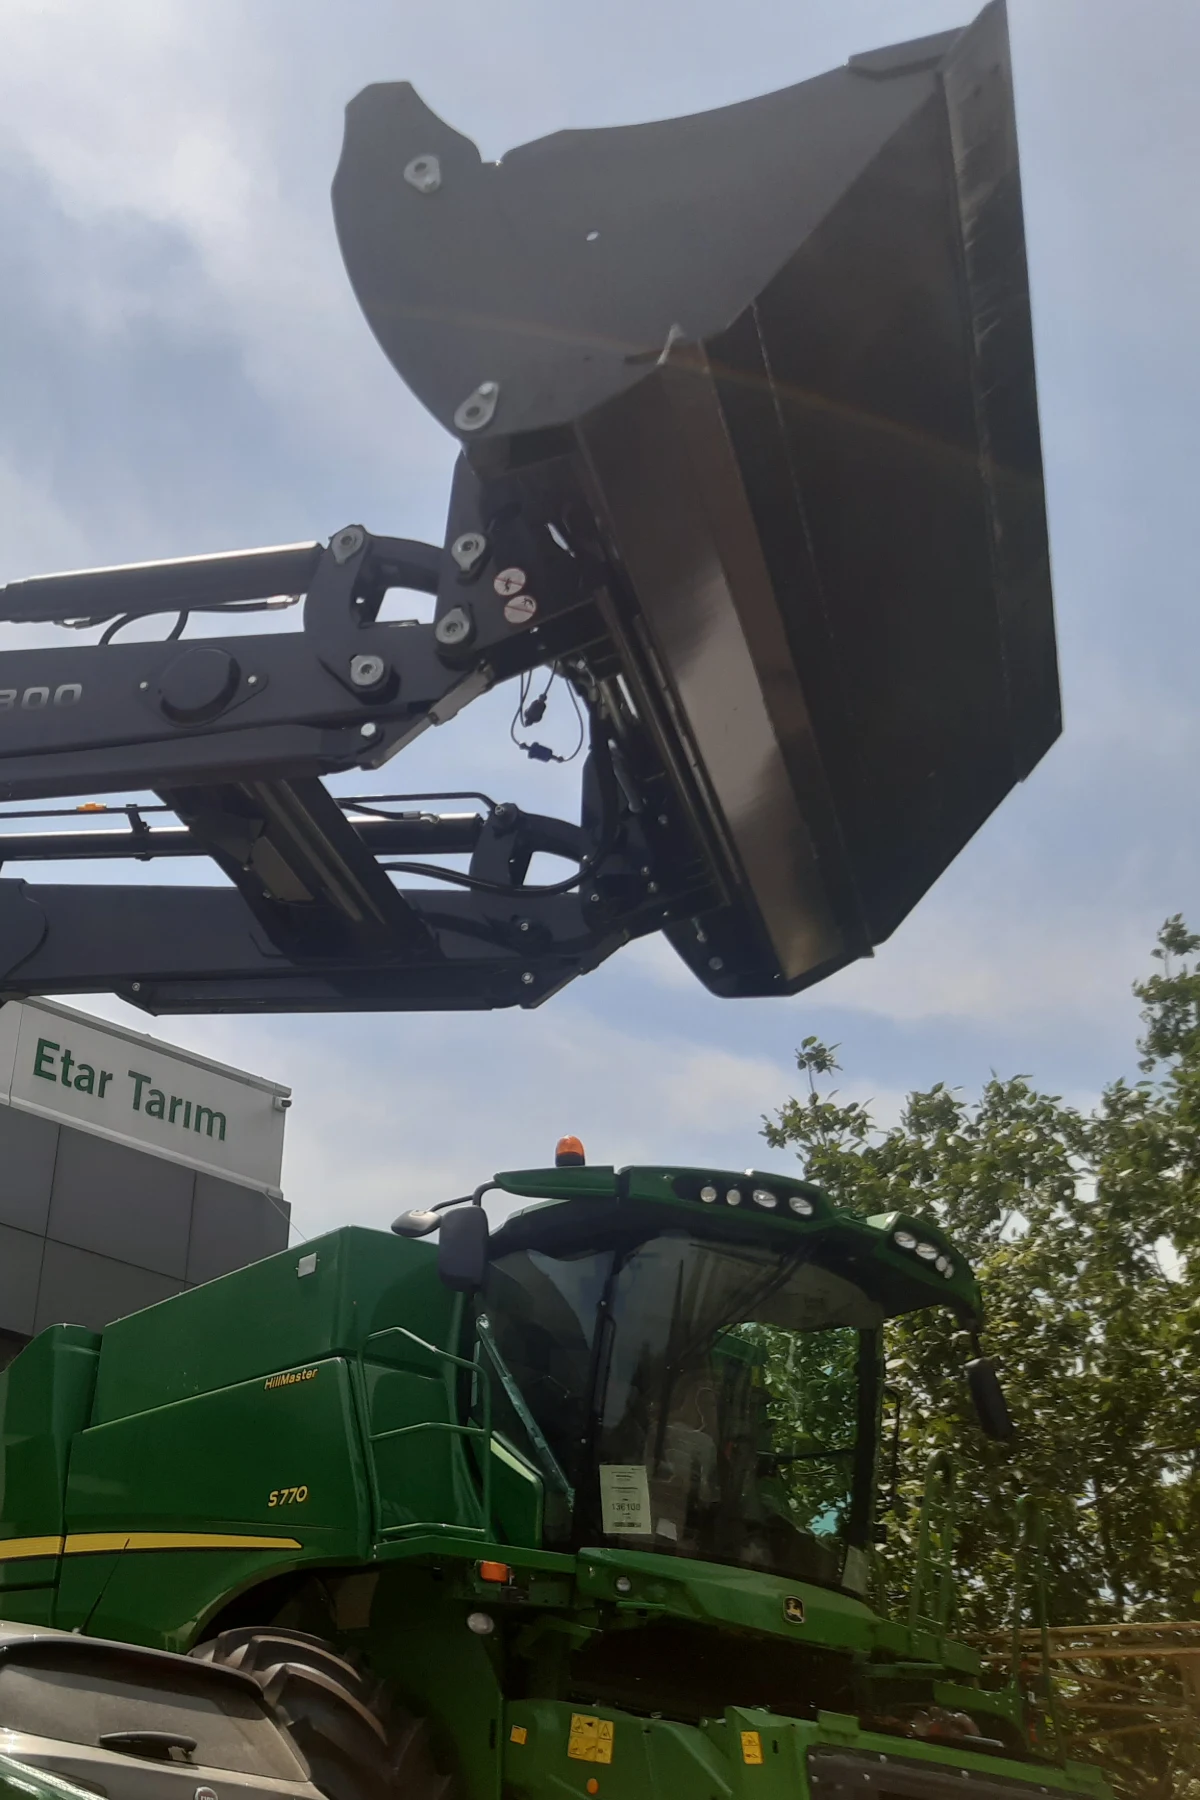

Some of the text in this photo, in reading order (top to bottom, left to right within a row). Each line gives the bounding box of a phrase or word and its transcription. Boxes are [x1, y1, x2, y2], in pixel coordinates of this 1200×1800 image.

[33, 1037, 227, 1142] Etar Tarım
[264, 1368, 318, 1390] HillMaster
[268, 1485, 308, 1507] S770
